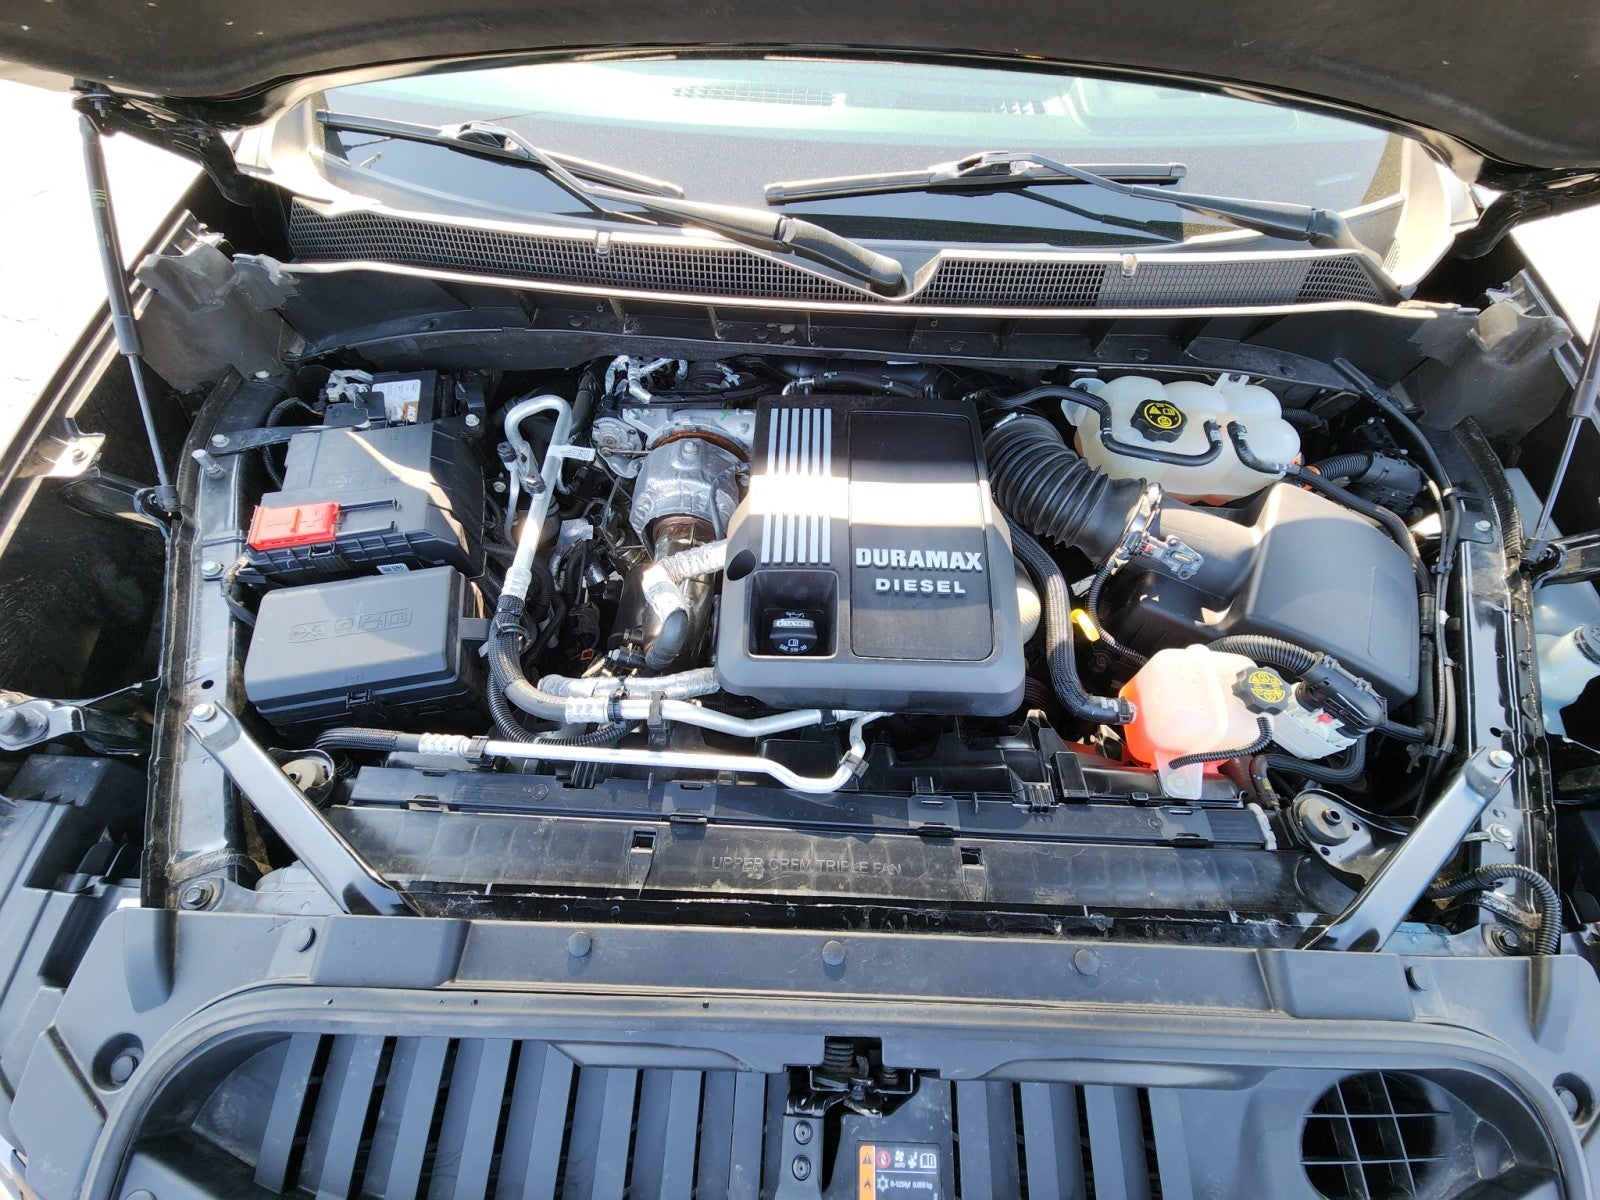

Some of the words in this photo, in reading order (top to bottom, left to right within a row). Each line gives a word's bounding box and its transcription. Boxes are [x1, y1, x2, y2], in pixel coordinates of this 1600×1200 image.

[856, 548, 982, 570] DURAMAX
[876, 578, 965, 594] DIESEL
[776, 619, 811, 627] dexos
[712, 856, 764, 871] UPPER
[816, 858, 869, 875] TRIPLE
[872, 861, 901, 876] FAN
